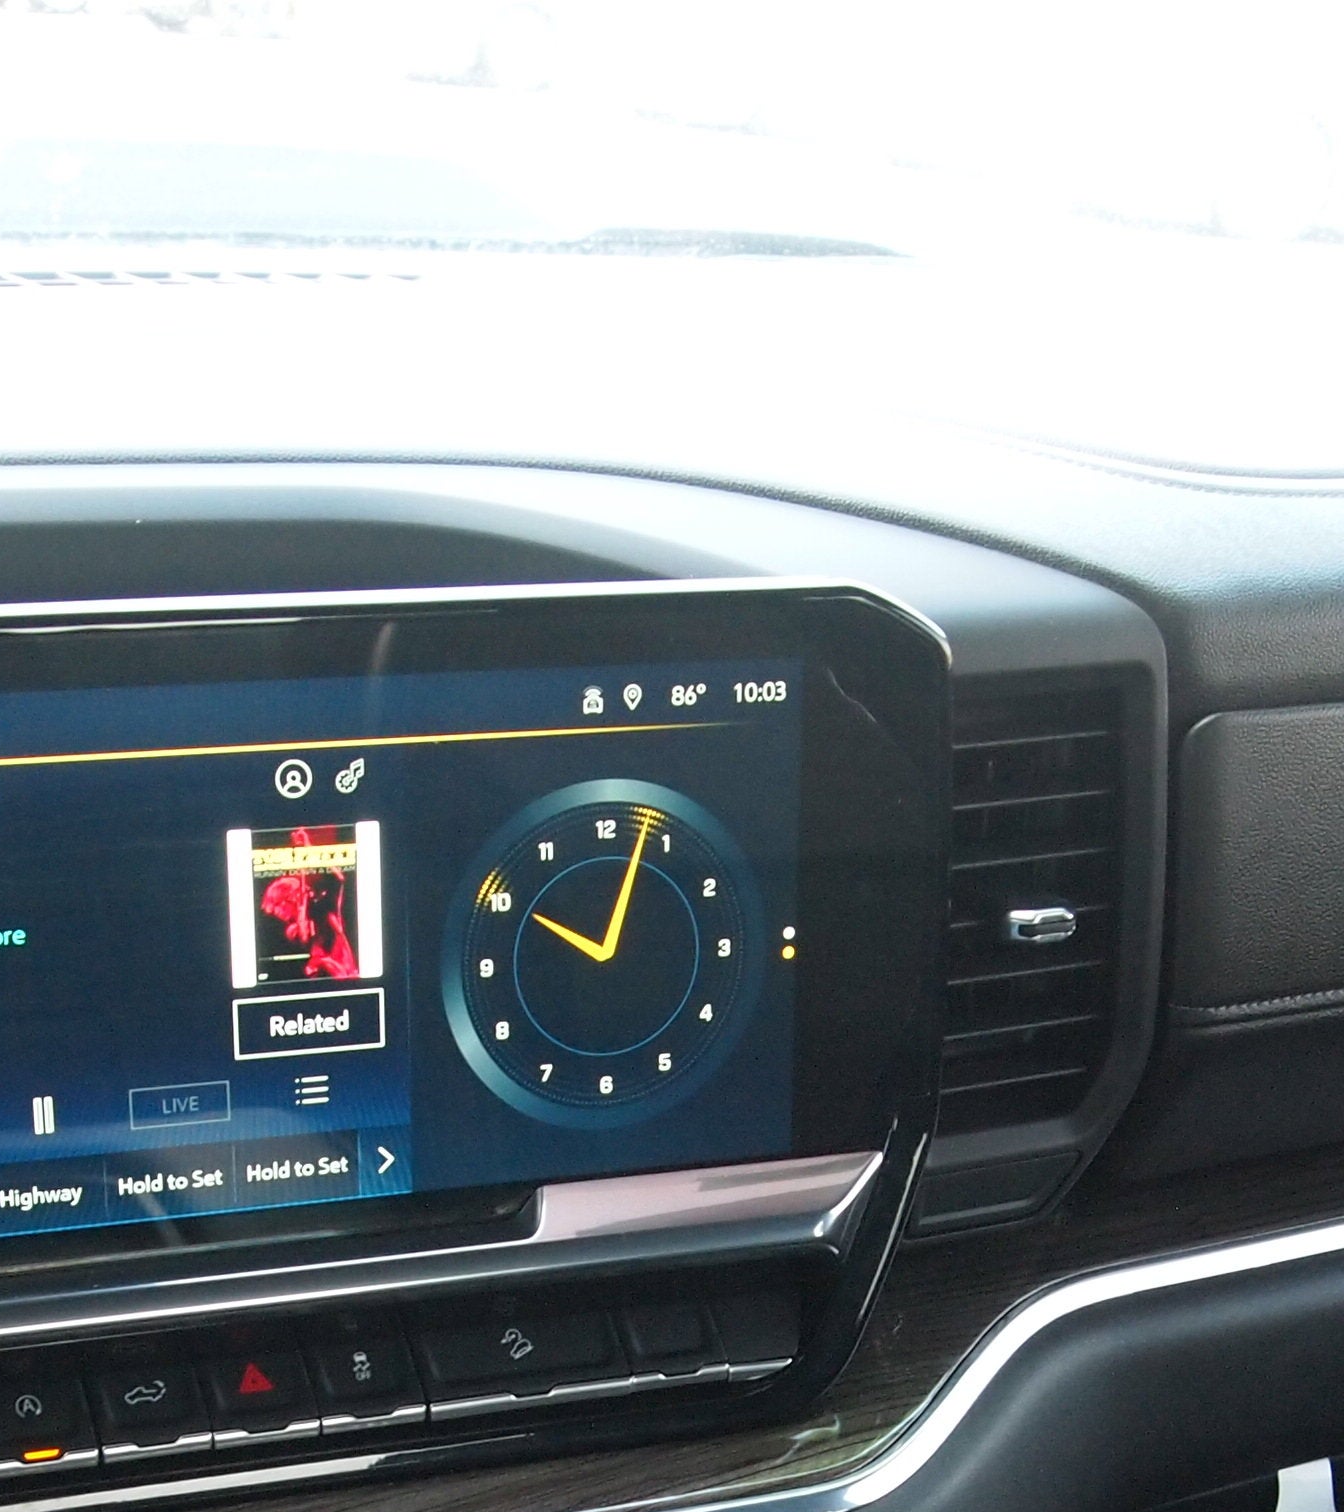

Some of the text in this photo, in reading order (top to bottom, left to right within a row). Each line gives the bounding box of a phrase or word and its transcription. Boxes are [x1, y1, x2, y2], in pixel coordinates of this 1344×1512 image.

[671, 683, 706, 706] 86°
[734, 681, 786, 702] 10:03
[596, 820, 616, 839] 12
[539, 842, 553, 860] 11
[662, 835, 670, 852] 1
[703, 879, 716, 897] 2
[491, 893, 512, 912] 10
[718, 939, 730, 957] 3
[480, 959, 493, 977] 9
[700, 1004, 712, 1021] 4
[270, 1009, 349, 1036] Related
[496, 1022, 509, 1040] 8
[659, 1053, 671, 1071] 5
[540, 1064, 552, 1082] 7
[600, 1076, 613, 1094] 6
[163, 1096, 199, 1114] LIVE
[247, 1156, 348, 1182] Hold to Set
[118, 1169, 223, 1196] Hold to Set
[0, 1186, 82, 1211] Highway
